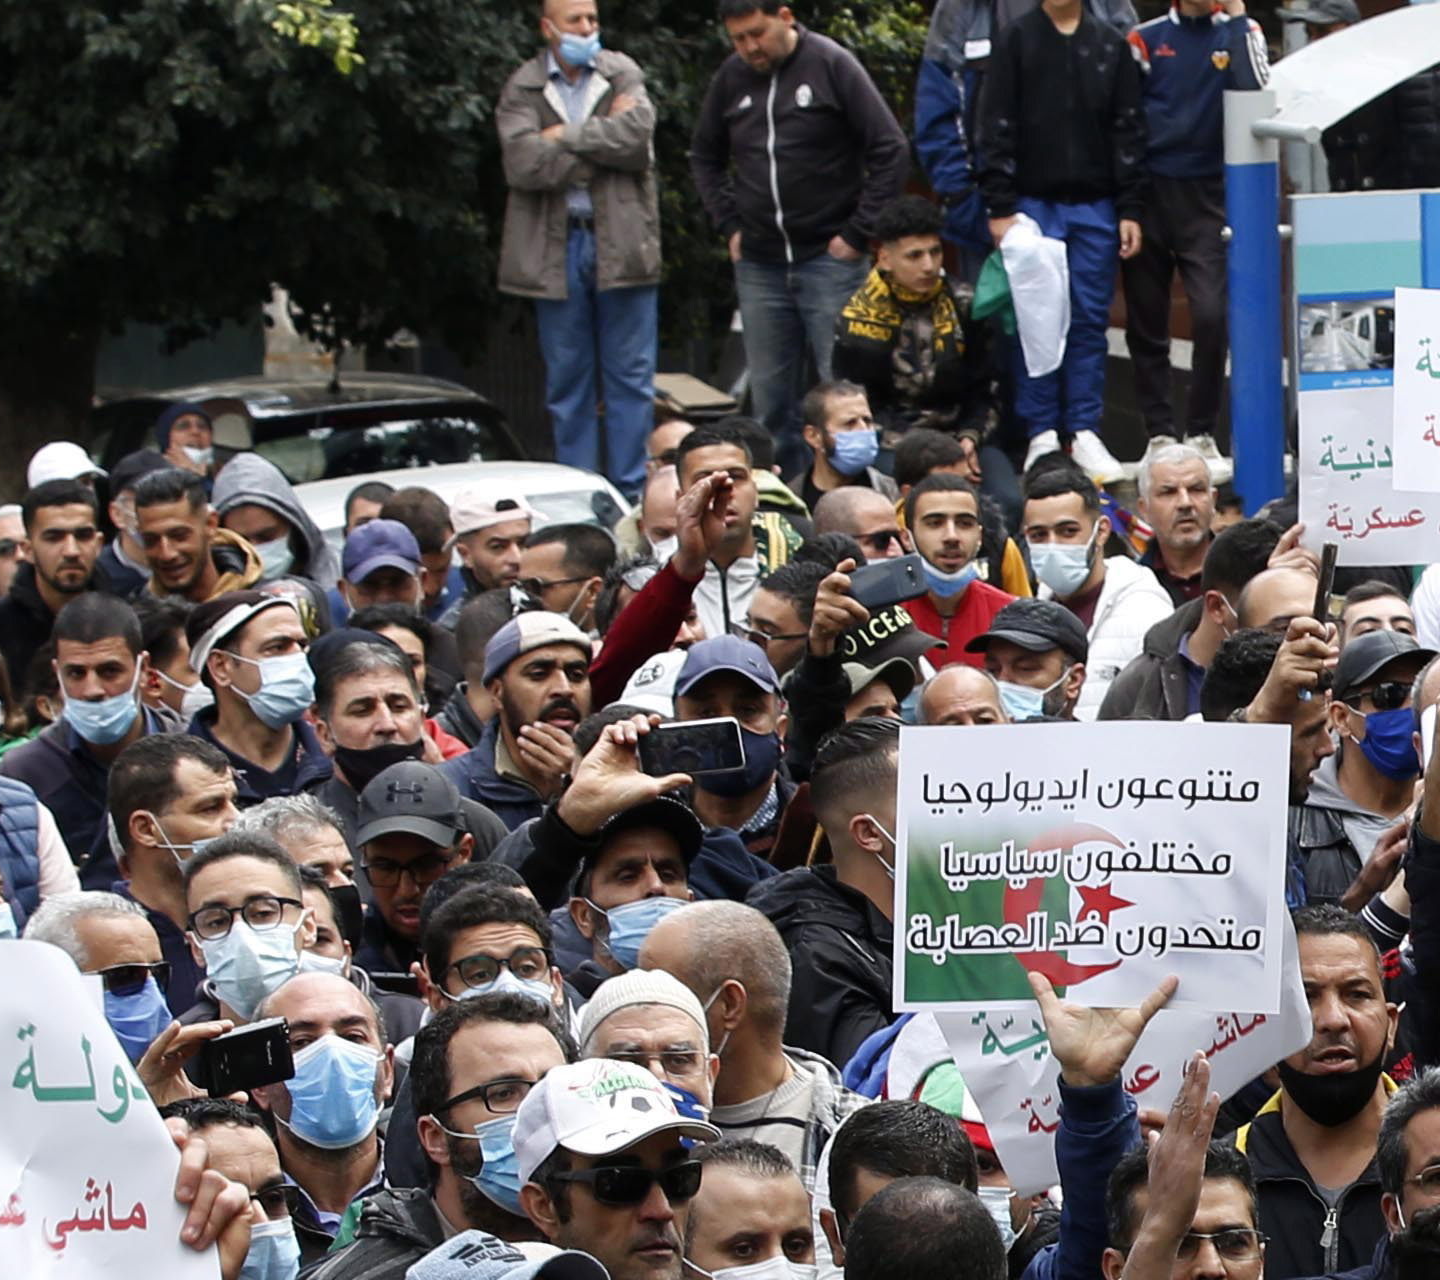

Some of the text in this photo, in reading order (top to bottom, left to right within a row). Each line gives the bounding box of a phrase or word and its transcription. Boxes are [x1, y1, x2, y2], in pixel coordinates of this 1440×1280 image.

[1319, 435, 1393, 480] دنيّة
[924, 770, 1258, 813] متنوعون ايديولوجيا
[940, 842, 1230, 890] مختلفون سياسيا
[908, 910, 1260, 965] متحدون ضد العصابة
[42, 1177, 148, 1258] ماشي
